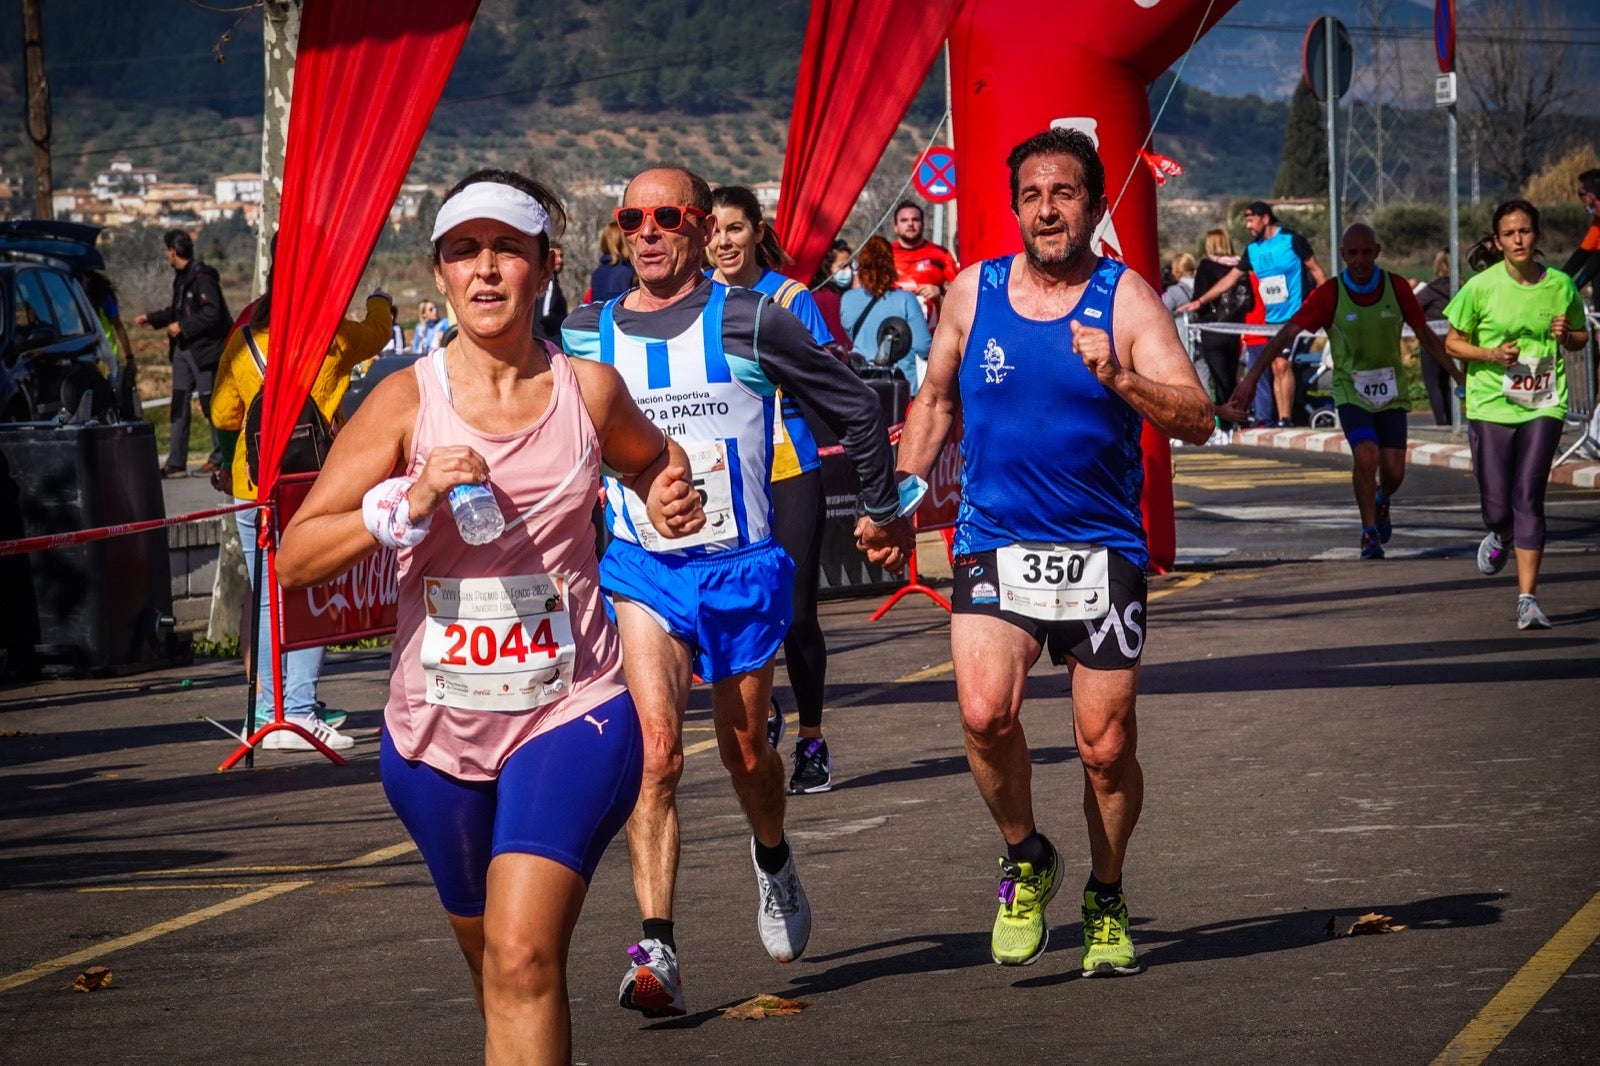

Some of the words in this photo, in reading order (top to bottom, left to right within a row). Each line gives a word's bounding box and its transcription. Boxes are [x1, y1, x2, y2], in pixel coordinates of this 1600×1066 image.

[1364, 382, 1388, 397] 470
[1510, 372, 1551, 391] 2027
[665, 391, 710, 403] Deportiva
[659, 410, 668, 420] a
[672, 402, 729, 418] PAZITO
[1022, 553, 1085, 585] 350
[532, 584, 549, 596] 2022
[440, 618, 560, 667] 2044
